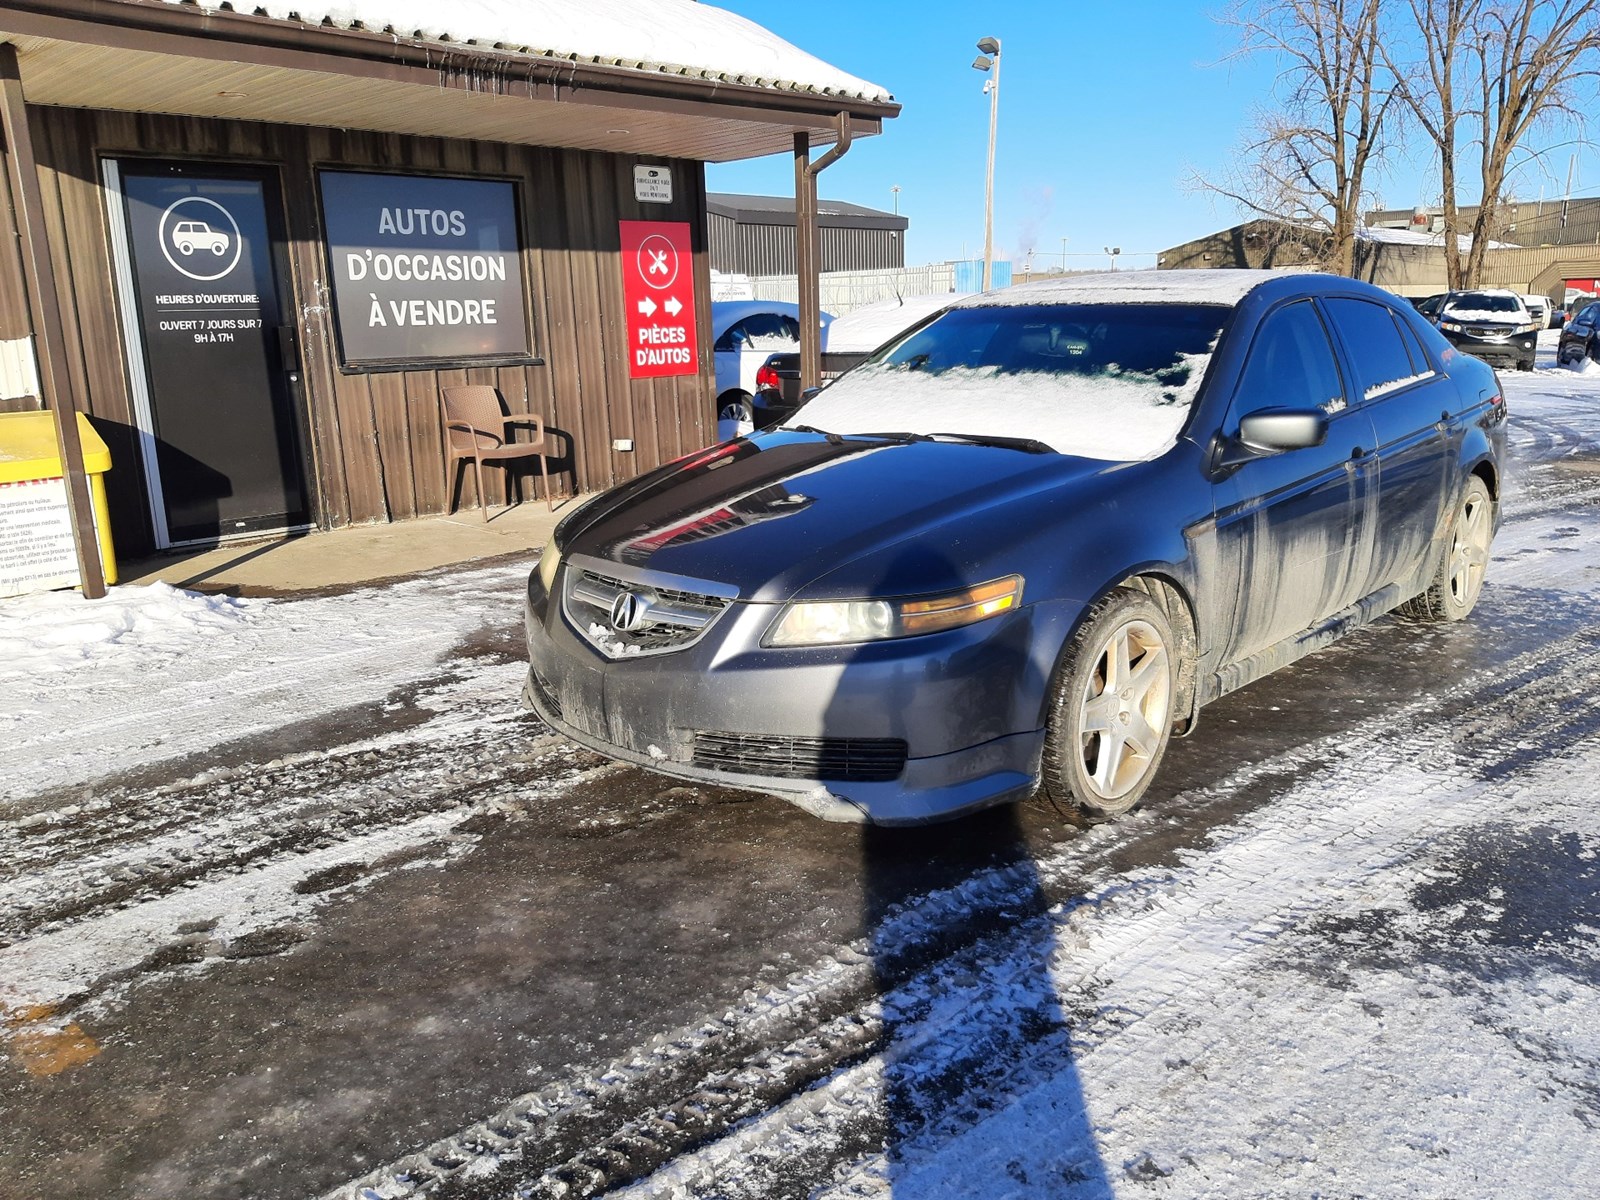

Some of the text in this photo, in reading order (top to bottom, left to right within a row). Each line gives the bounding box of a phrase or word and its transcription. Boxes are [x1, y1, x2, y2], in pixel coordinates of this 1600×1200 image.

[378, 207, 466, 236] AUTOS
[346, 248, 506, 281] D'OCCASION
[155, 294, 194, 304] HEURES
[368, 292, 497, 327] À VENDRE
[159, 318, 263, 331] OUVERT 7 JOURS SUR 7
[638, 323, 686, 345] PIÈCES
[193, 331, 234, 343] 9H À 17H
[636, 347, 691, 366] D'AUTOS
